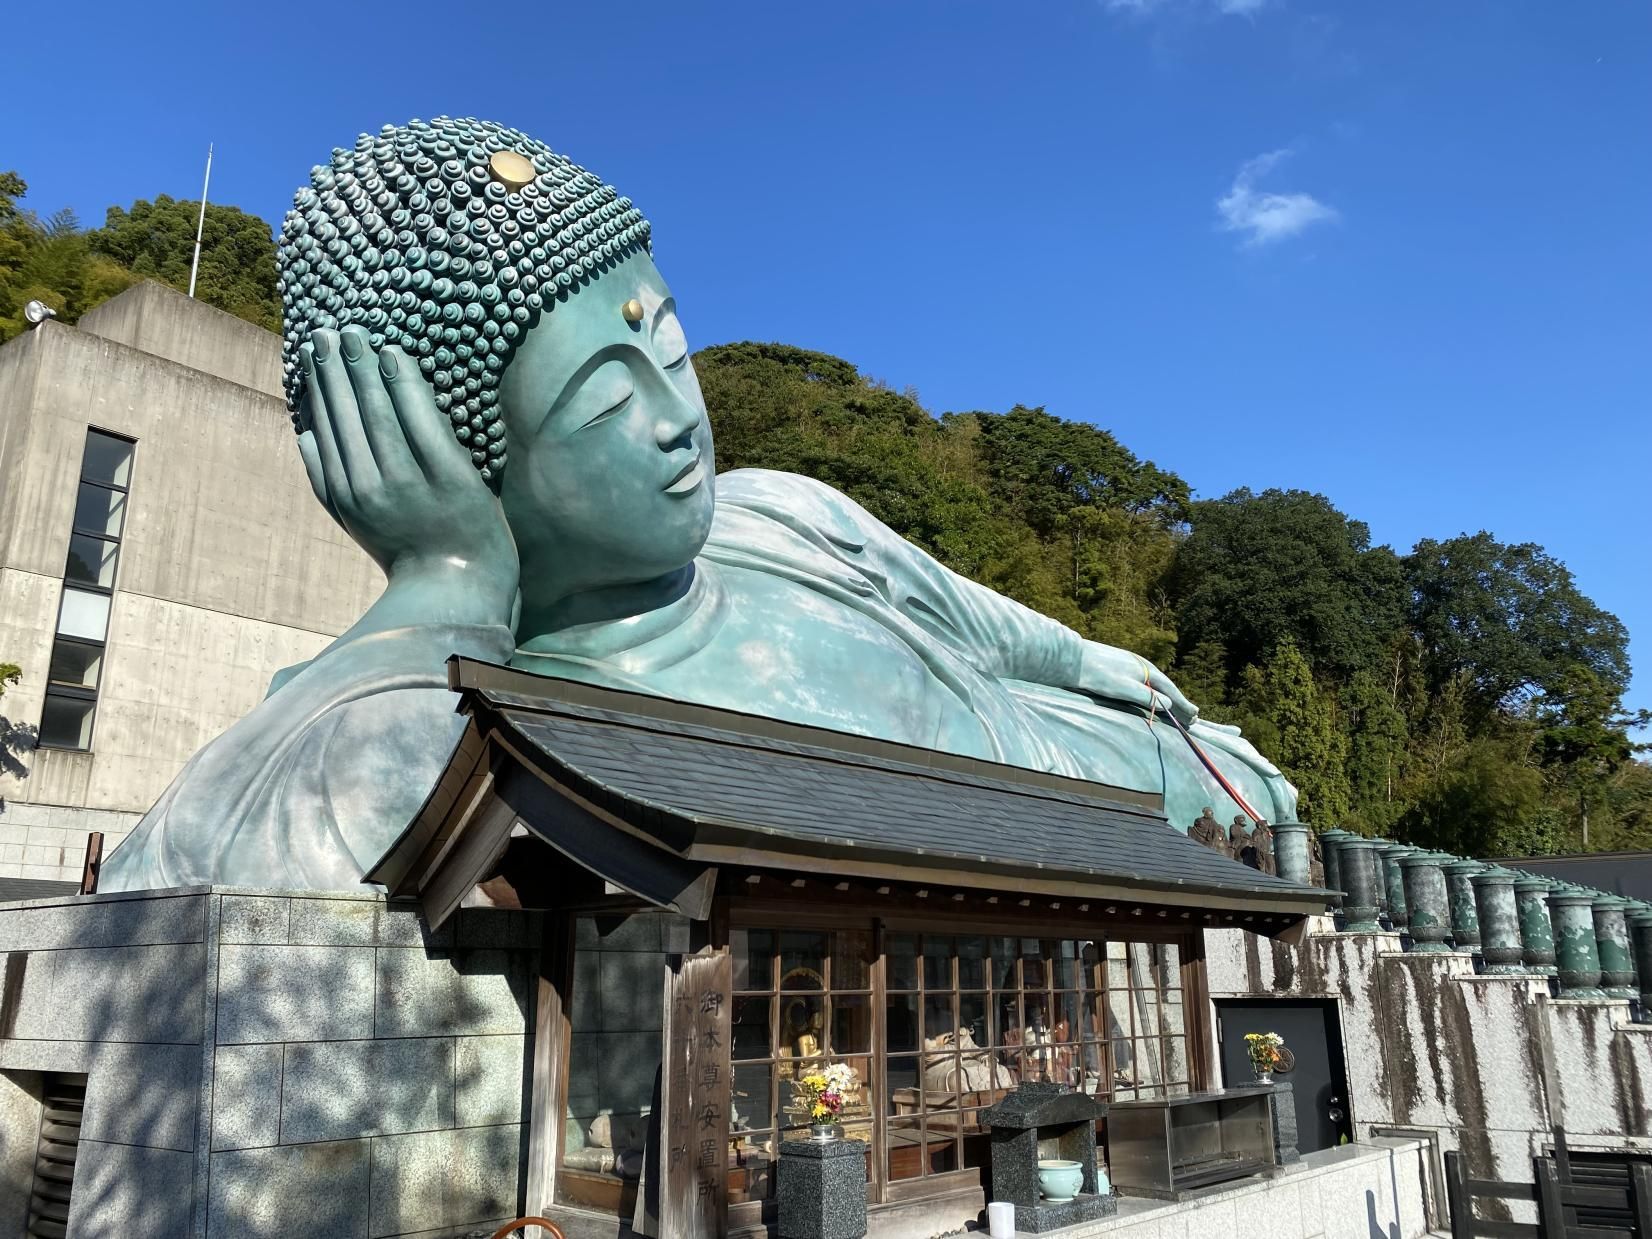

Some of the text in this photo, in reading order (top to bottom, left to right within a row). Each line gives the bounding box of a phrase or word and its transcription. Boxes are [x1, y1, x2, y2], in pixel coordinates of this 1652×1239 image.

[697, 990, 722, 1206] 御本尊安置所
